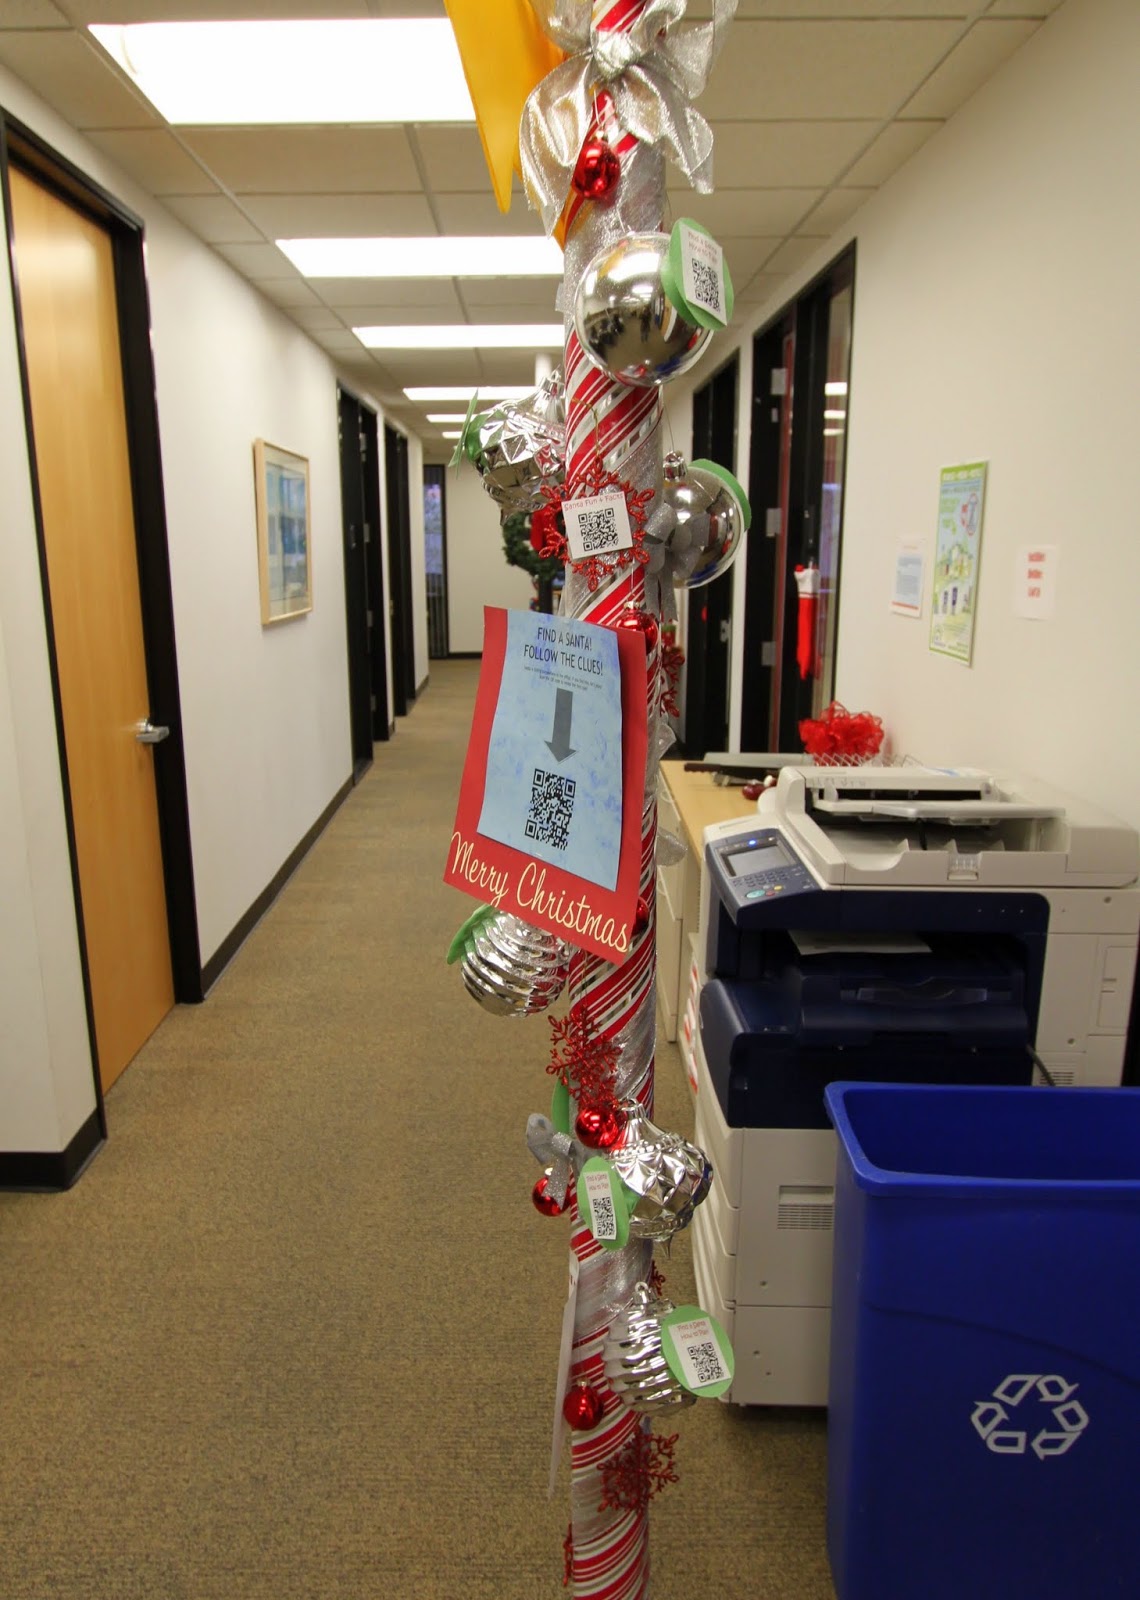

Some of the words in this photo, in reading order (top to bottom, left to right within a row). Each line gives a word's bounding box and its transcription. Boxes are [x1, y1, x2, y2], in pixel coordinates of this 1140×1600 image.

[564, 503, 584, 512] Santa
[585, 498, 598, 507] Fun
[605, 493, 624, 502] Facts
[537, 627, 557, 643] FIND
[558, 632, 564, 644] A
[565, 633, 592, 651] SANTA!
[523, 645, 559, 663] FOLLOW
[560, 652, 576, 668] THE
[577, 656, 603, 676] CLUES!
[450, 831, 509, 908] Merry
[516, 862, 628, 953] Christmas
